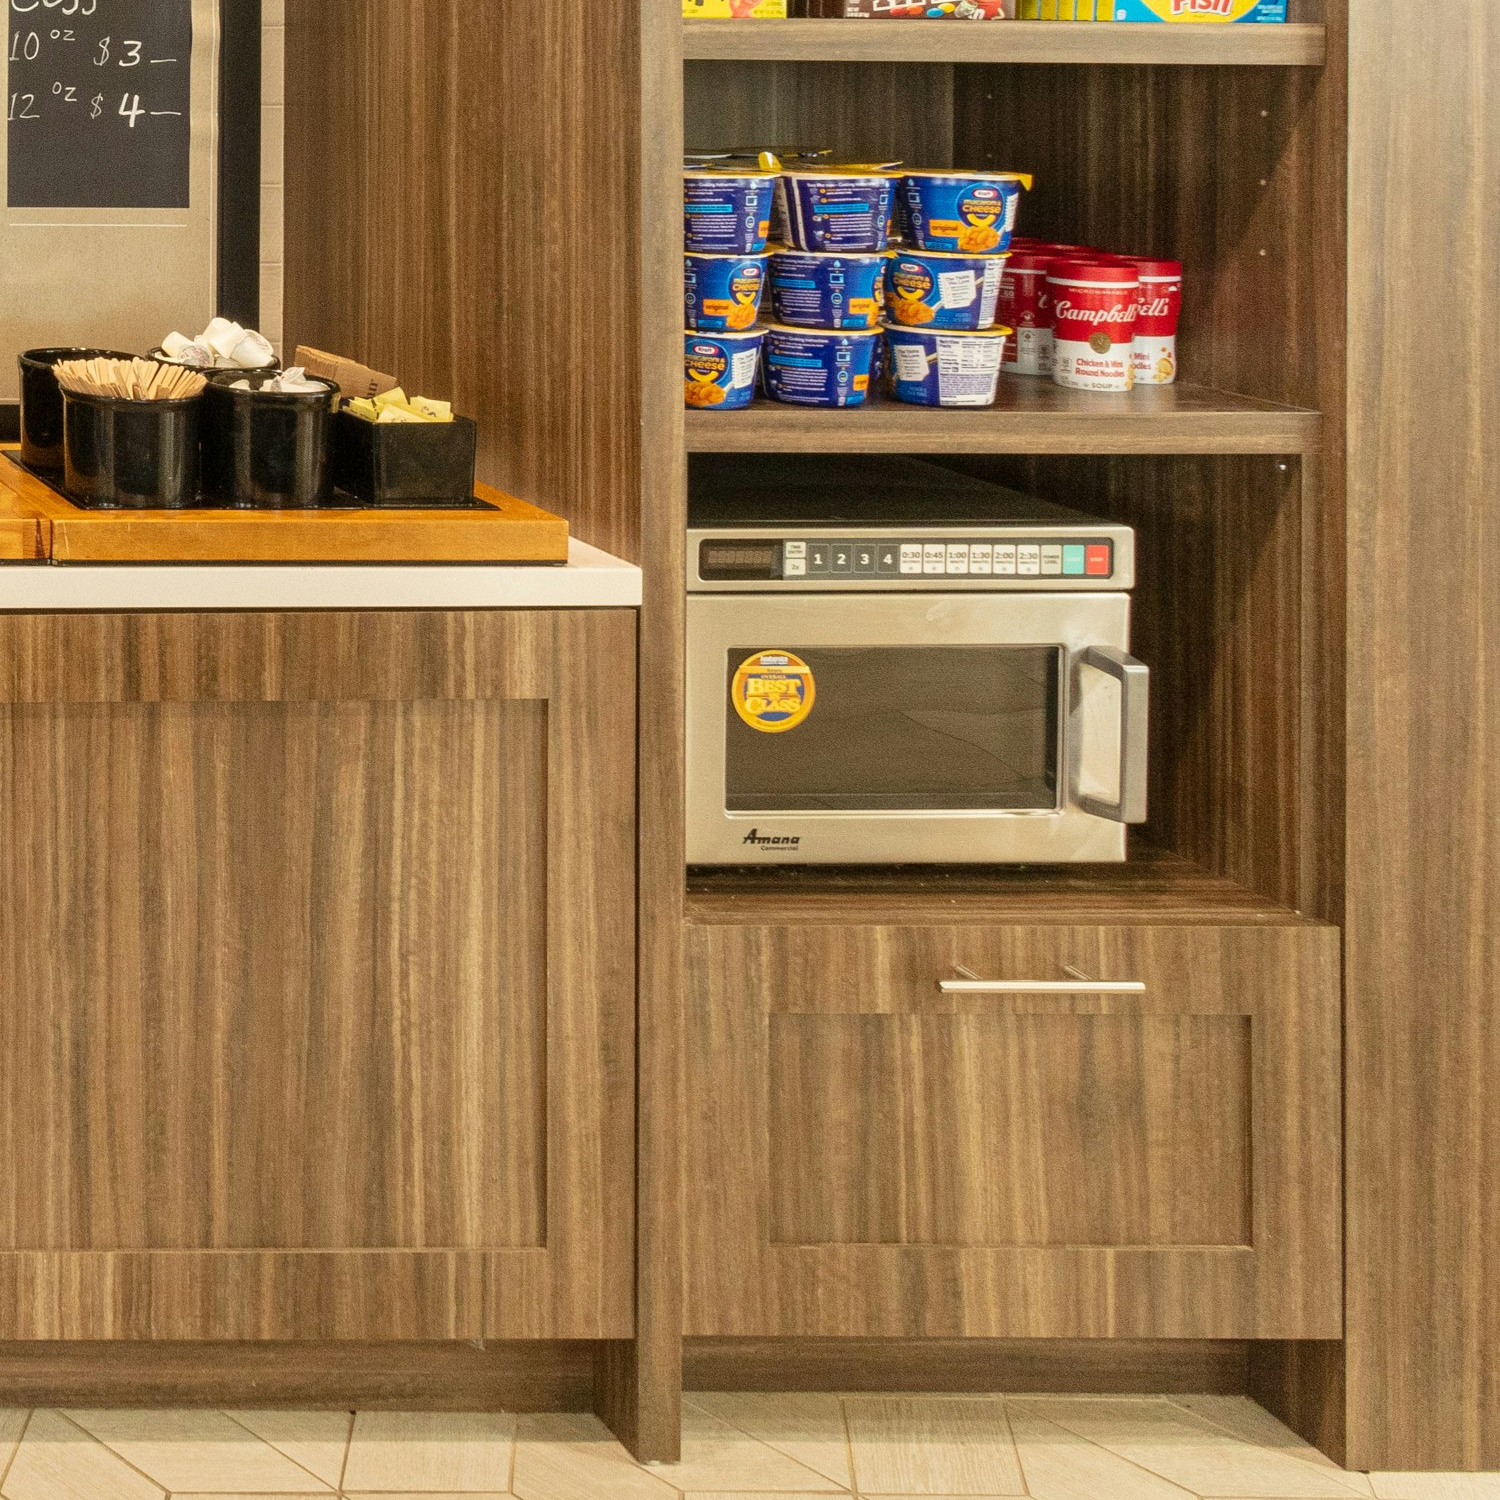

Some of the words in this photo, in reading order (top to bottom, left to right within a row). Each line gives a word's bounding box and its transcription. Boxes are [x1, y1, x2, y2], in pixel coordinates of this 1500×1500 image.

[9, 31, 40, 61] 10
[50, 29, 75, 40] oz
[8, 93, 40, 121] 12
[52, 82, 77, 101] oz
[1076, 358, 1104, 368] Chicken
[1111, 360, 1123, 368] Mini
[1076, 368, 1099, 377] Round
[1100, 369, 1125, 378] Noodles
[814, 554, 822, 564] 1
[837, 554, 846, 564] 2
[861, 554, 869, 564] 3
[883, 554, 893, 564] 4
[743, 828, 800, 844] Amana
